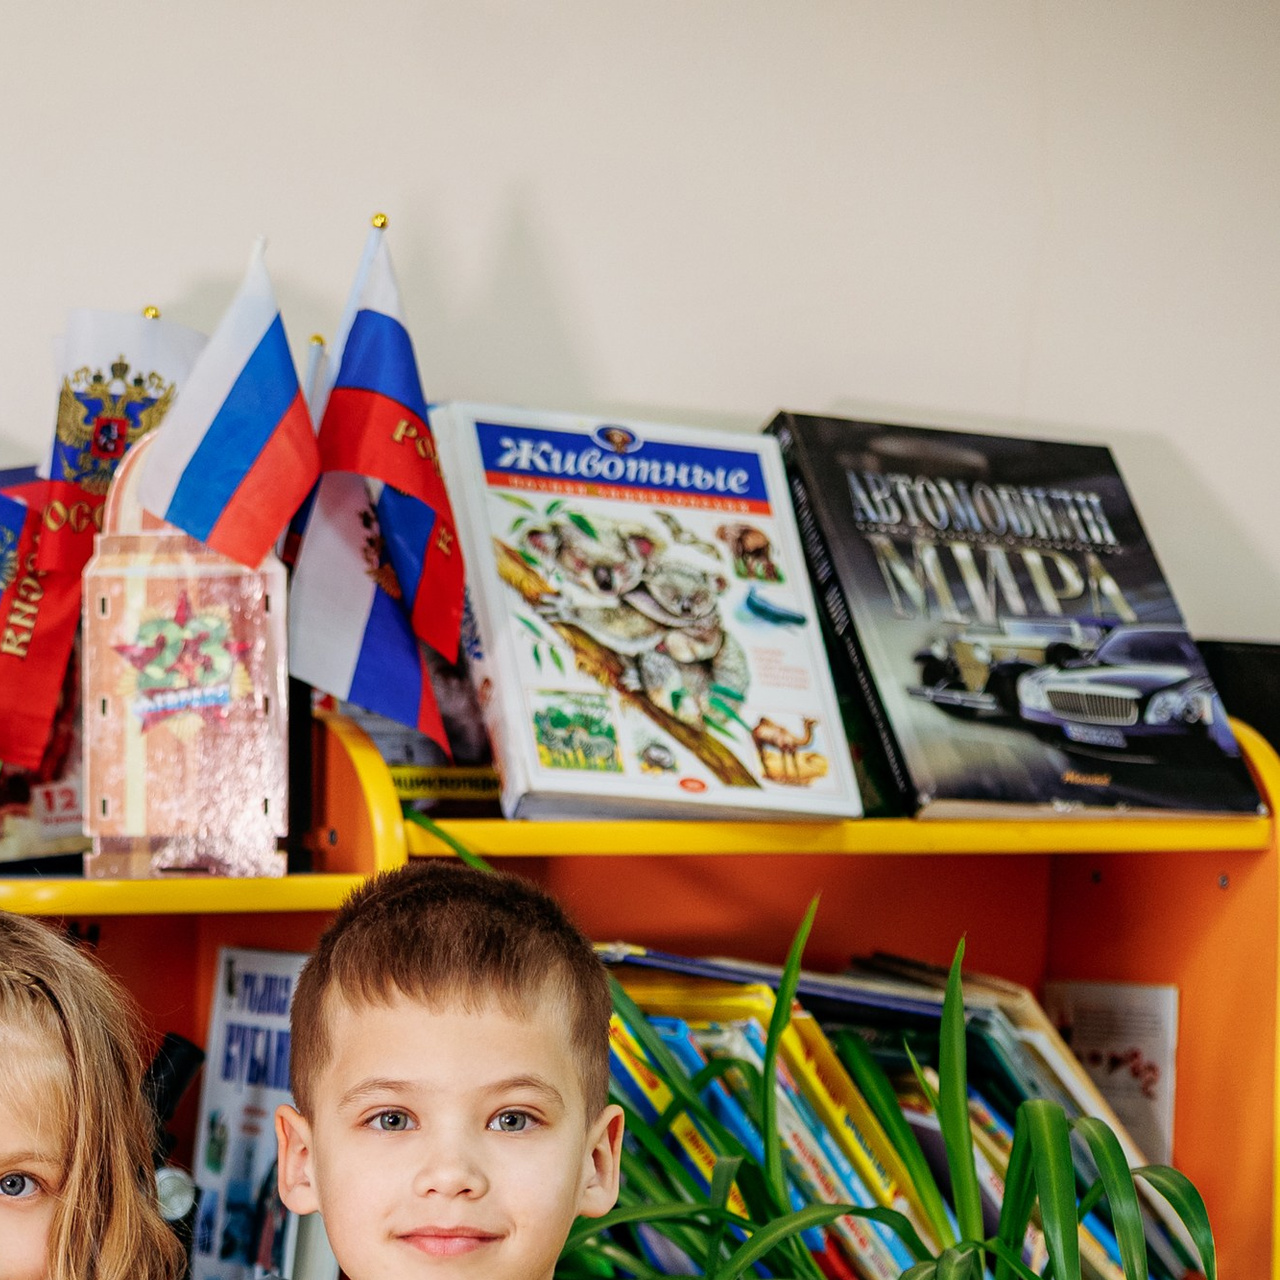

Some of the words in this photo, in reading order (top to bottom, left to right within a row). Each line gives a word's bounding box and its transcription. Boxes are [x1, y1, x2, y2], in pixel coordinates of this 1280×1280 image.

[497, 437, 750, 494] Животные
[844, 468, 1118, 546] АВТОМОБИЛИ
[866, 532, 1139, 626] МИРА
[136, 617, 233, 690] 23
